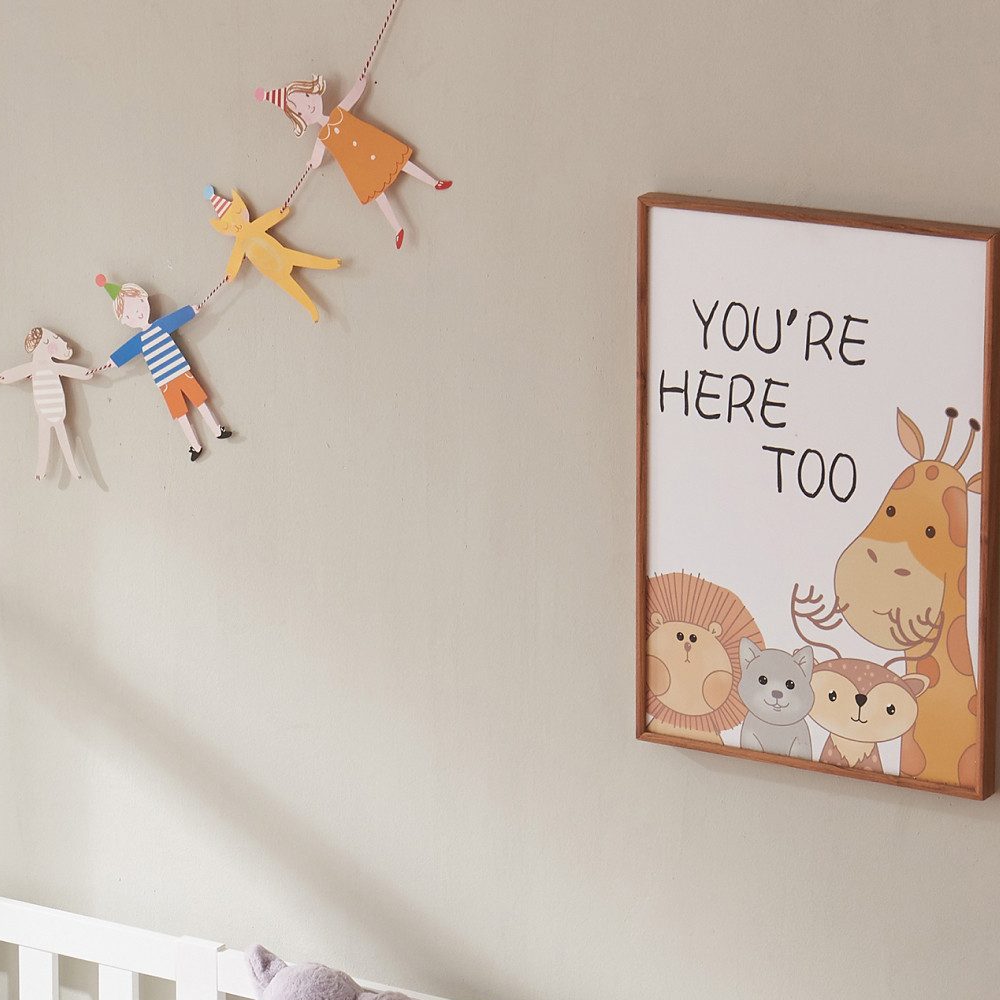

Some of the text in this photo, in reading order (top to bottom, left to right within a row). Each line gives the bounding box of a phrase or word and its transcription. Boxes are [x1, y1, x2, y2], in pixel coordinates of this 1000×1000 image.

[692, 298, 869, 366] YOU'RE
[659, 369, 790, 429] HERE
[761, 445, 857, 503] TOO
